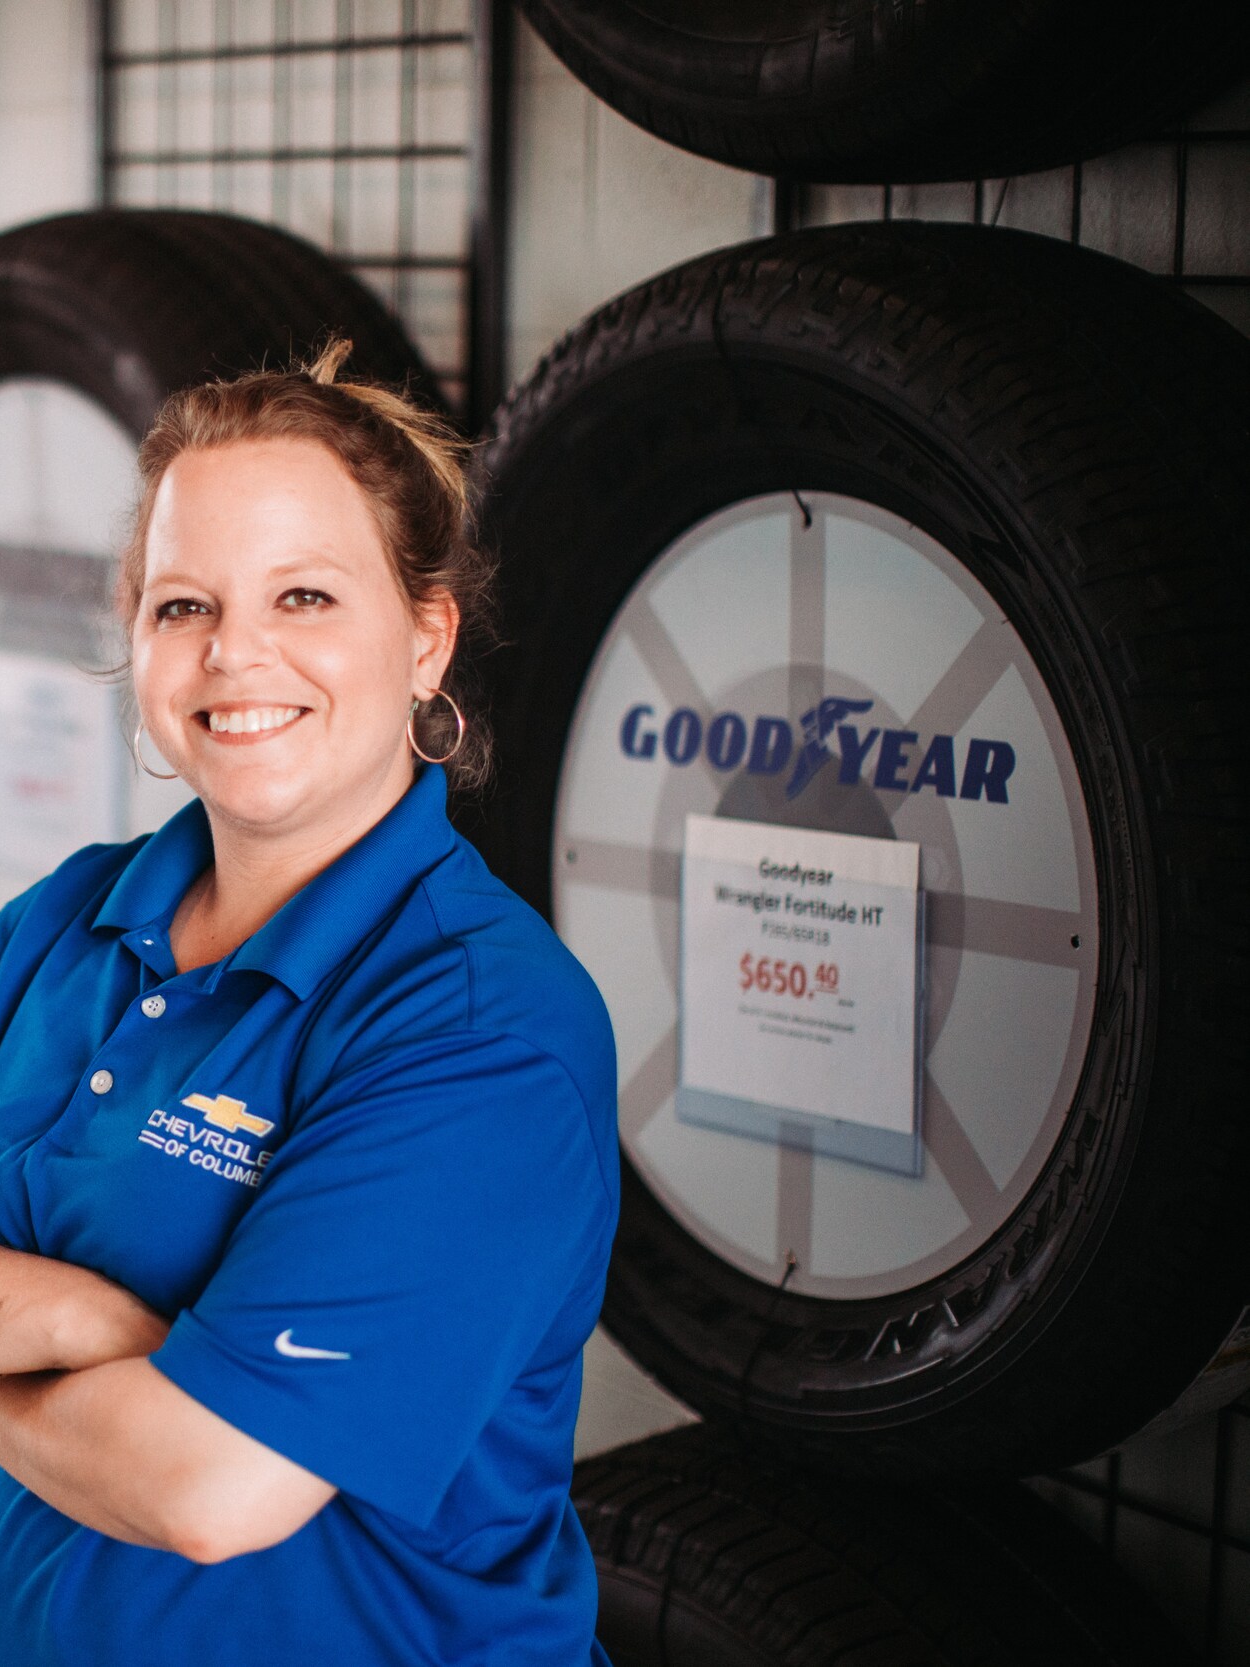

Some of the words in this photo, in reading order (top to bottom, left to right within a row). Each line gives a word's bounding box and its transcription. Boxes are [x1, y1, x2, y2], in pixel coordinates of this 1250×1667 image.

[619, 698, 1017, 805] GOODYEAR
[759, 857, 833, 886] Goodyear
[715, 885, 781, 913] Wrangler
[785, 893, 857, 924] Fortitude
[862, 906, 884, 926] HT
[164, 1139, 189, 1158] OF
